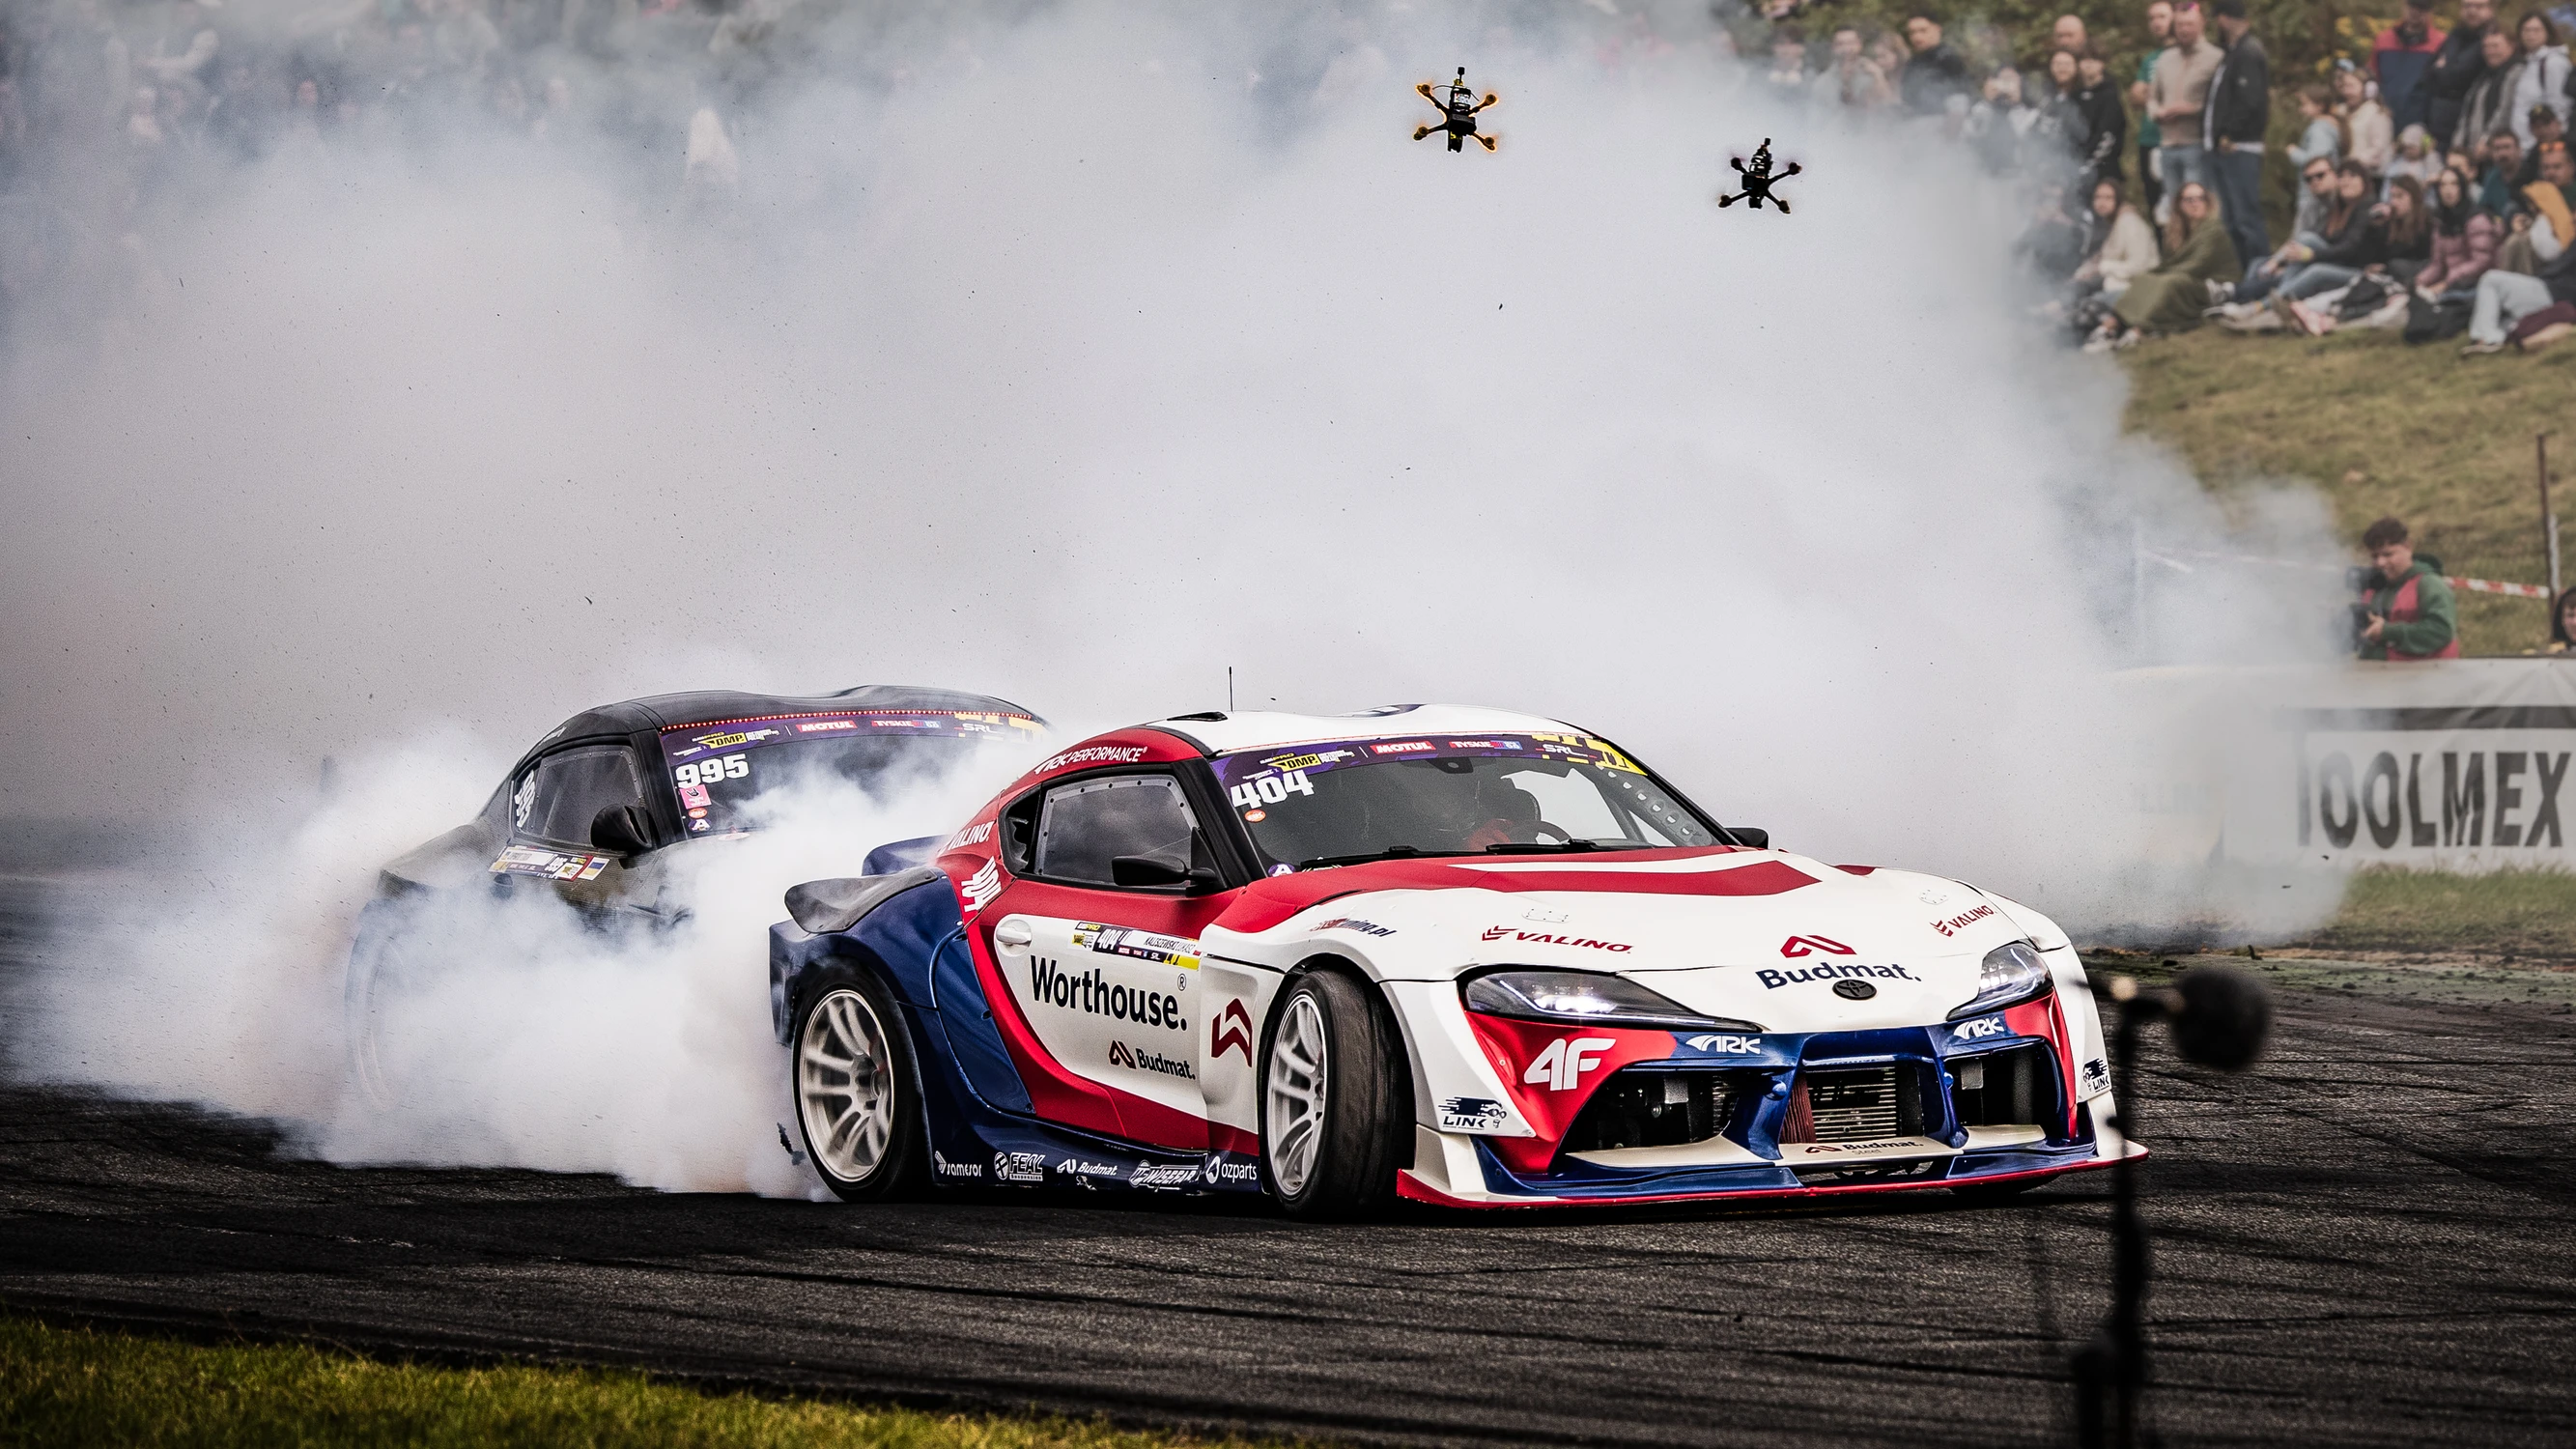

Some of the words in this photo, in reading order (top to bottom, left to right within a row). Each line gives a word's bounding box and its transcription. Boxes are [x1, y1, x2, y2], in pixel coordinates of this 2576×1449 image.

[801, 721, 855, 732] MOTUL
[874, 720, 914, 728] TYSKIE
[1376, 742, 1433, 754] MOTUL
[1455, 741, 1496, 750] TYSKIE
[1542, 744, 1589, 758] SRL
[675, 753, 750, 789] 995
[1230, 769, 1316, 810] 404
[961, 856, 1003, 913] 404
[1947, 904, 1996, 929] VALINO
[1096, 928, 1123, 951] 404
[1515, 931, 1634, 954] VALINO
[1755, 962, 1922, 990] Budmat.
[1030, 954, 1188, 1032] Worthouse.
[1135, 1047, 1197, 1081] Budmat.
[1523, 1037, 1617, 1091] 4F
[2092, 1075, 2109, 1091] LINK
[1443, 1115, 1486, 1129] LINK
[1842, 1140, 1924, 1151] Budmat.
[1009, 1151, 1046, 1175] FEAL
[1077, 1161, 1118, 1176] Budmat.
[1221, 1162, 1258, 1183] ozparts
